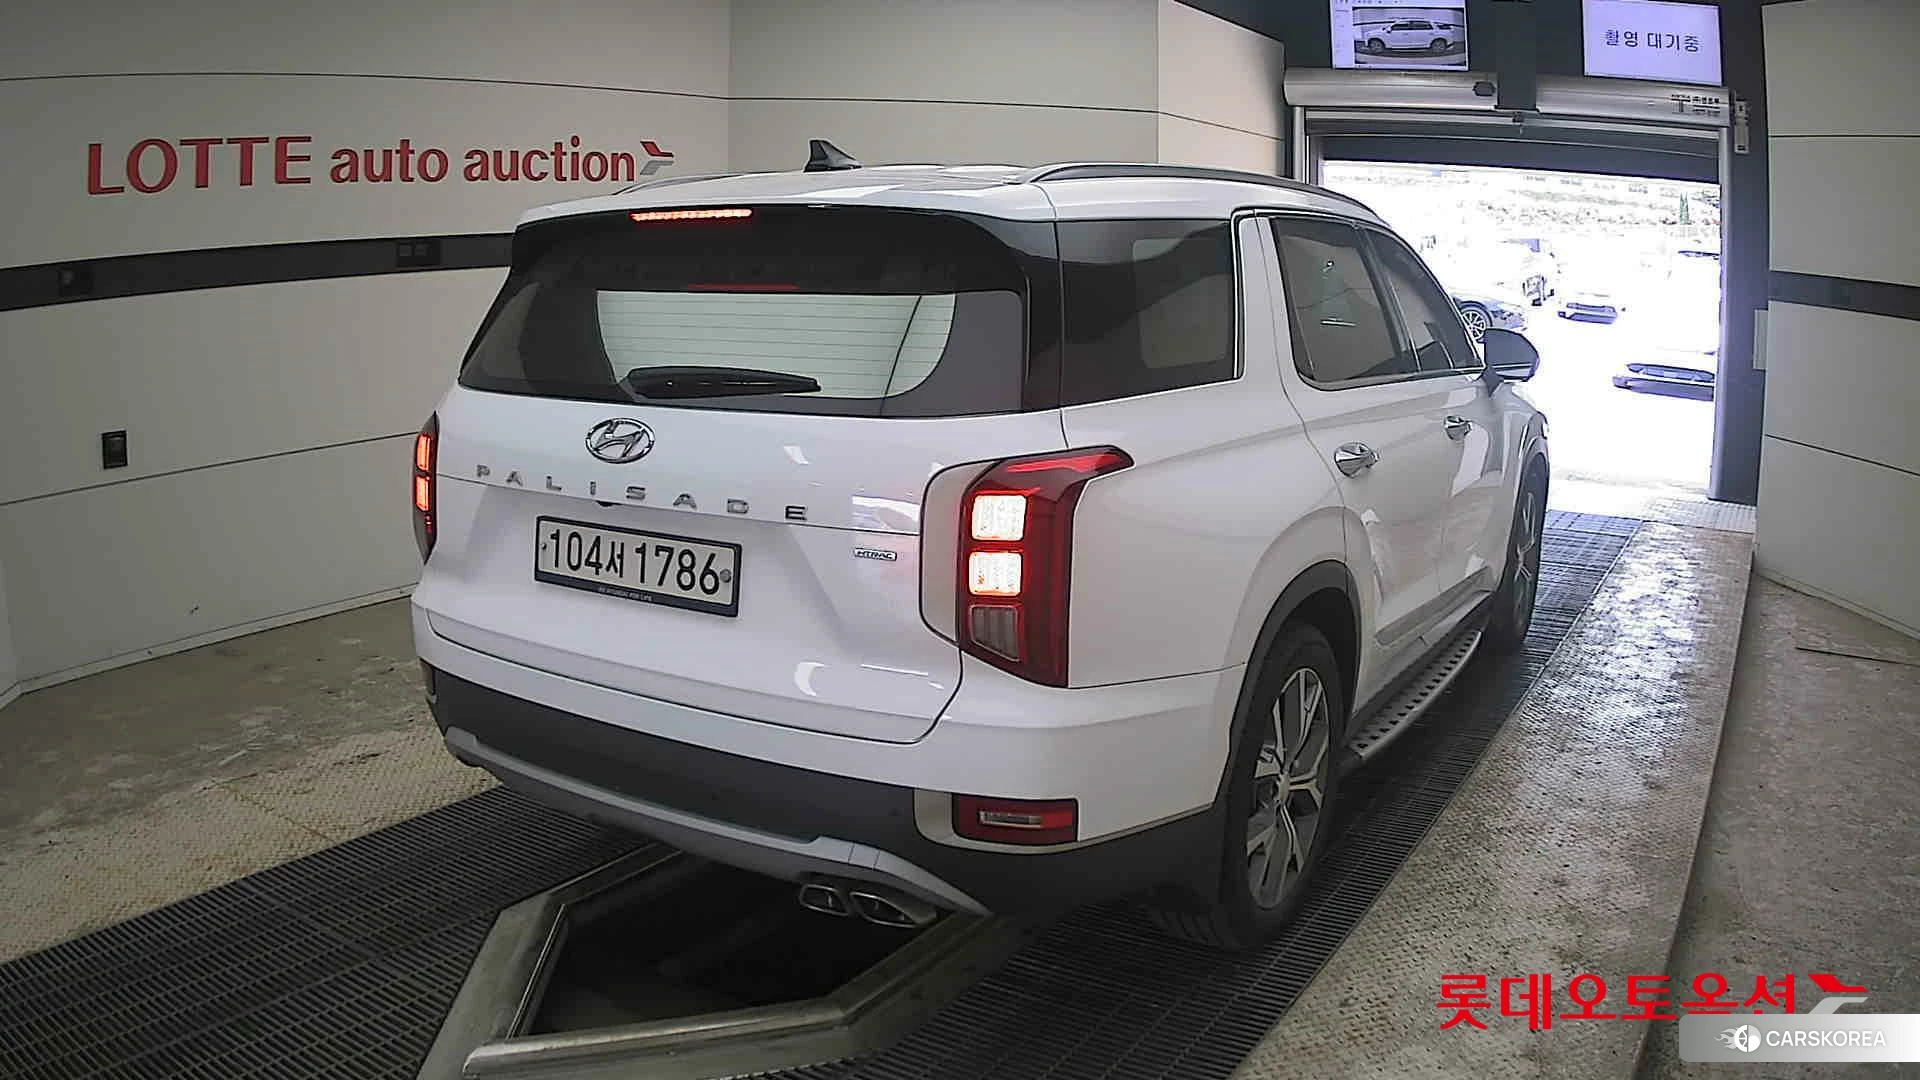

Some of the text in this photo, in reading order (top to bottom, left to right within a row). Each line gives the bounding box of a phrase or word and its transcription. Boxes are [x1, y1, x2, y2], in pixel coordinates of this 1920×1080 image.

[1646, 32, 1699, 53] 대기중
[87, 135, 635, 195] LOTTE auto auction
[476, 463, 808, 522] PALISADE
[634, 541, 720, 596] 1786
